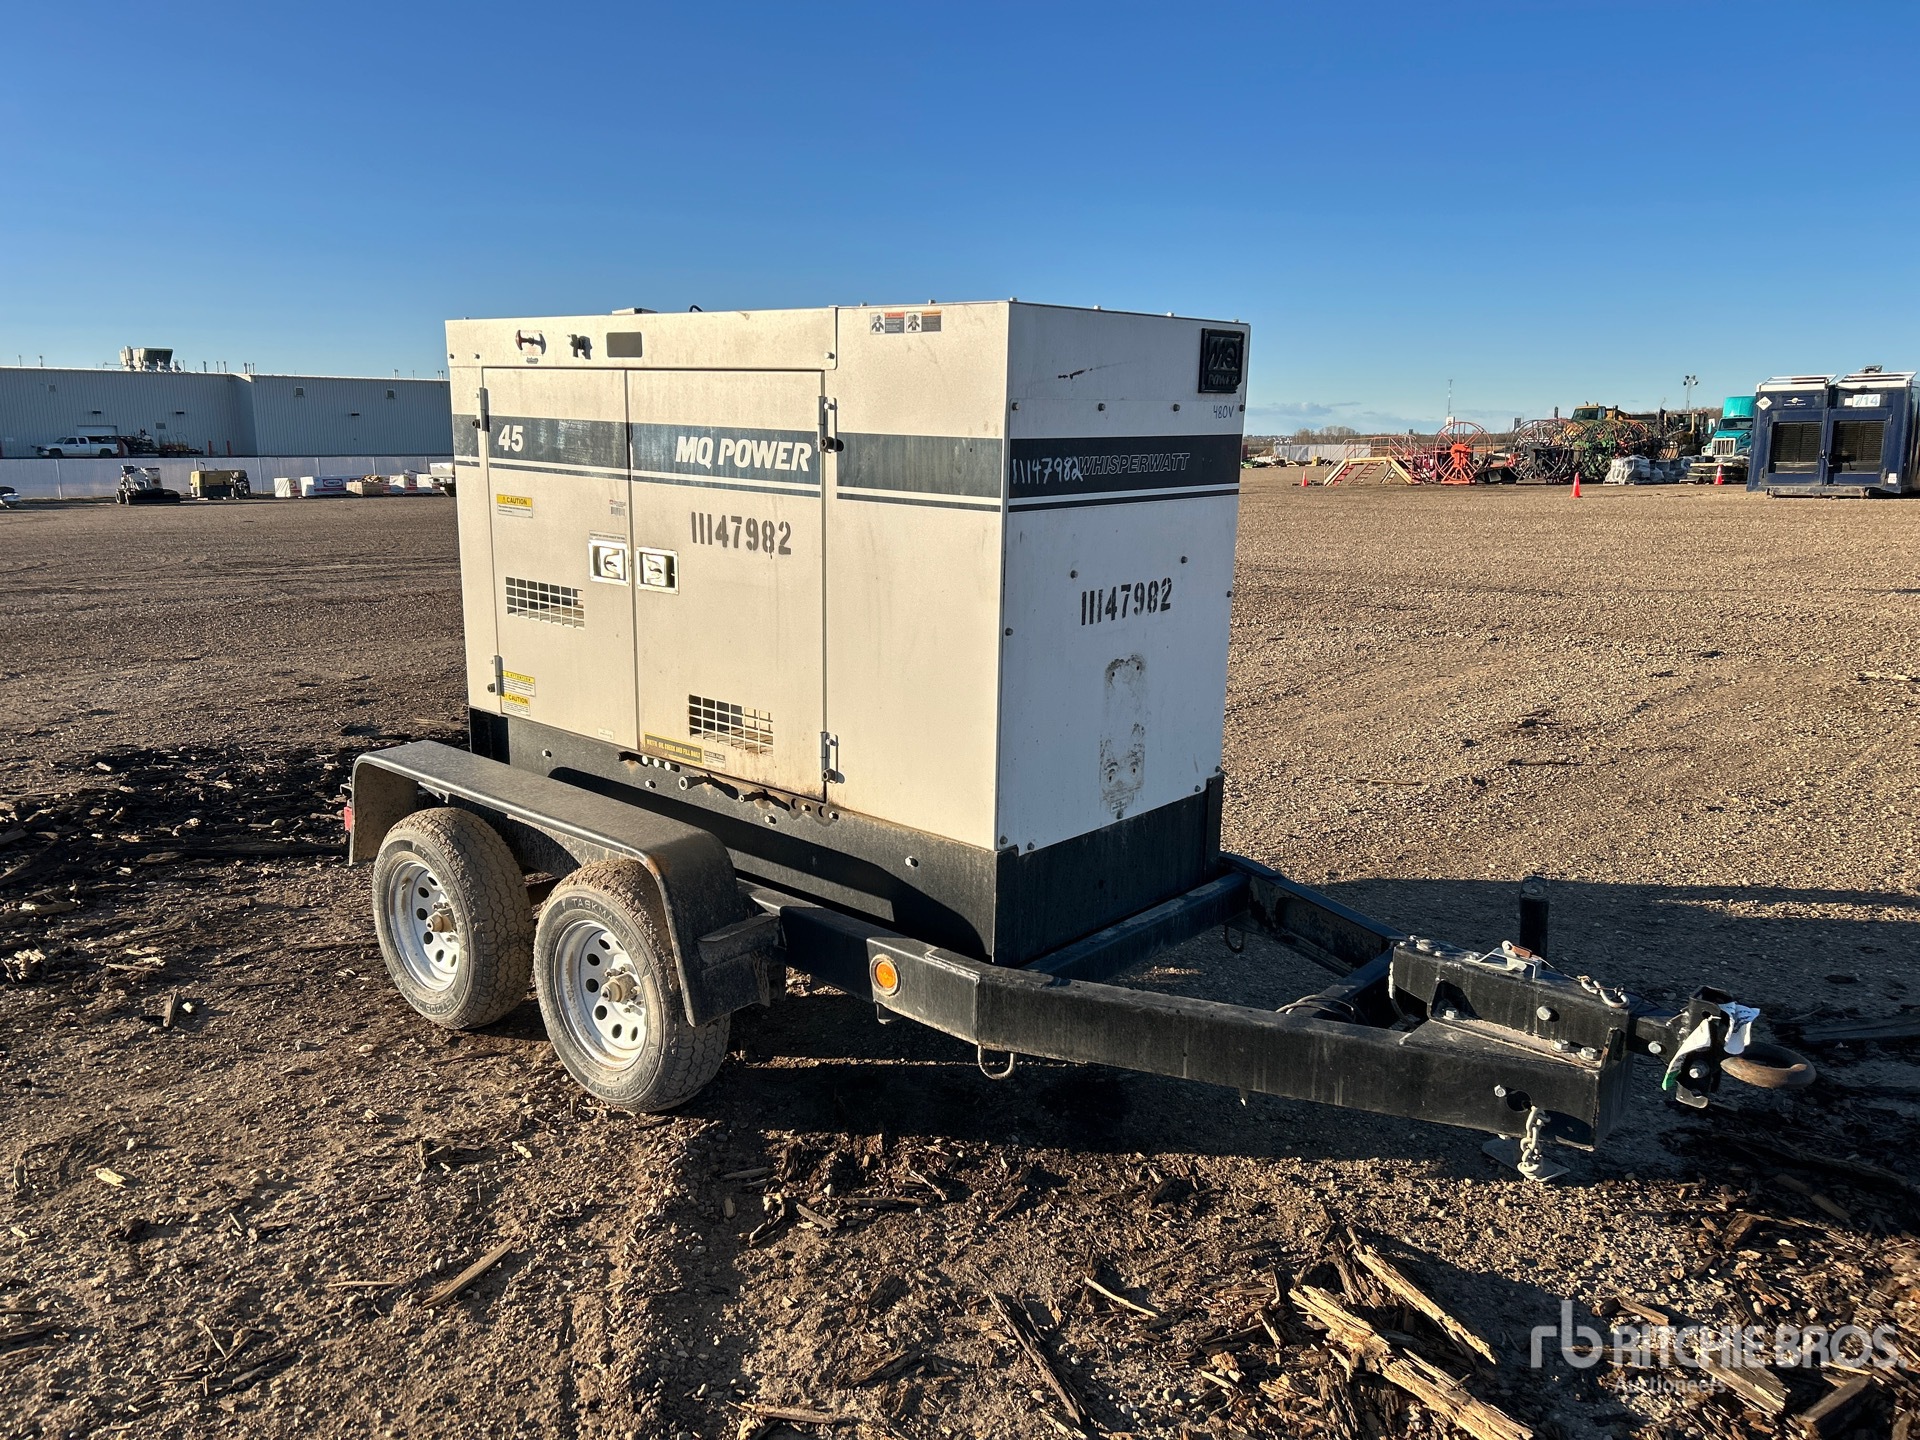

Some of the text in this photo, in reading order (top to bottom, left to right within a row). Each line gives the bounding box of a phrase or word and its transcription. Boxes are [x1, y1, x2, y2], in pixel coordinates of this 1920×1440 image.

[1213, 404, 1235, 419] 480V
[498, 424, 524, 452] 45
[675, 435, 812, 472] MQ POWER
[1078, 453, 1191, 476] WHISPERWATT
[506, 497, 528, 505] CAUTION
[691, 511, 792, 556] 11147982
[1081, 577, 1173, 626] 11147982
